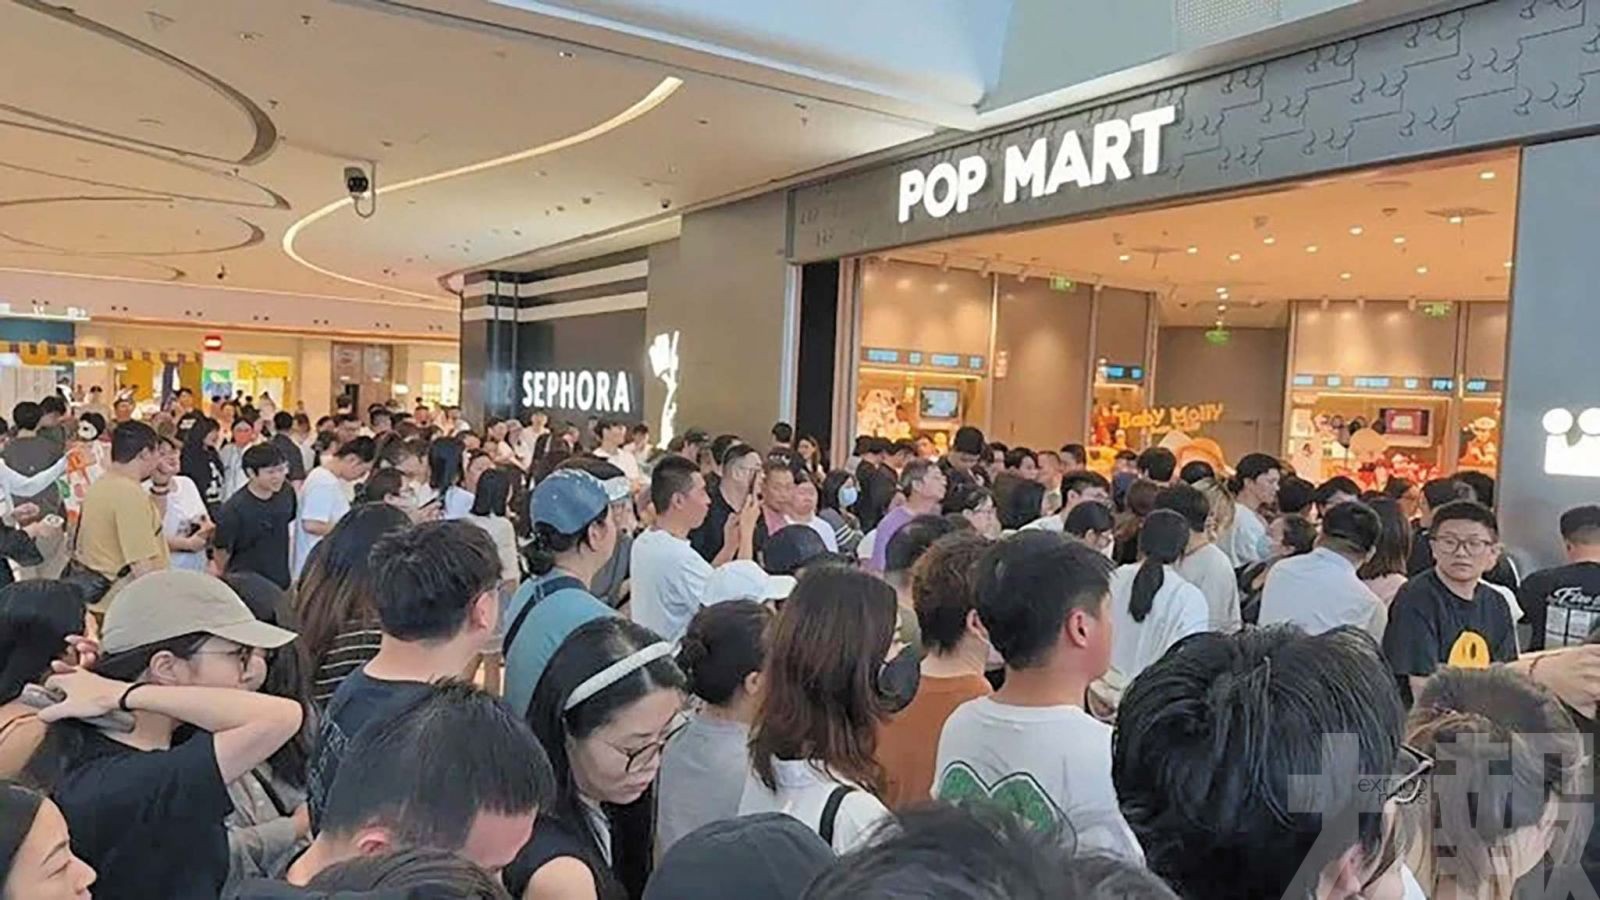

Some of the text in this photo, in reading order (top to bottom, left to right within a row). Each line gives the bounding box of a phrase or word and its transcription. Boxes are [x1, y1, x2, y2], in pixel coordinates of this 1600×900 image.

[898, 106, 1176, 223] POP MART
[521, 369, 631, 415] SEPHORA
